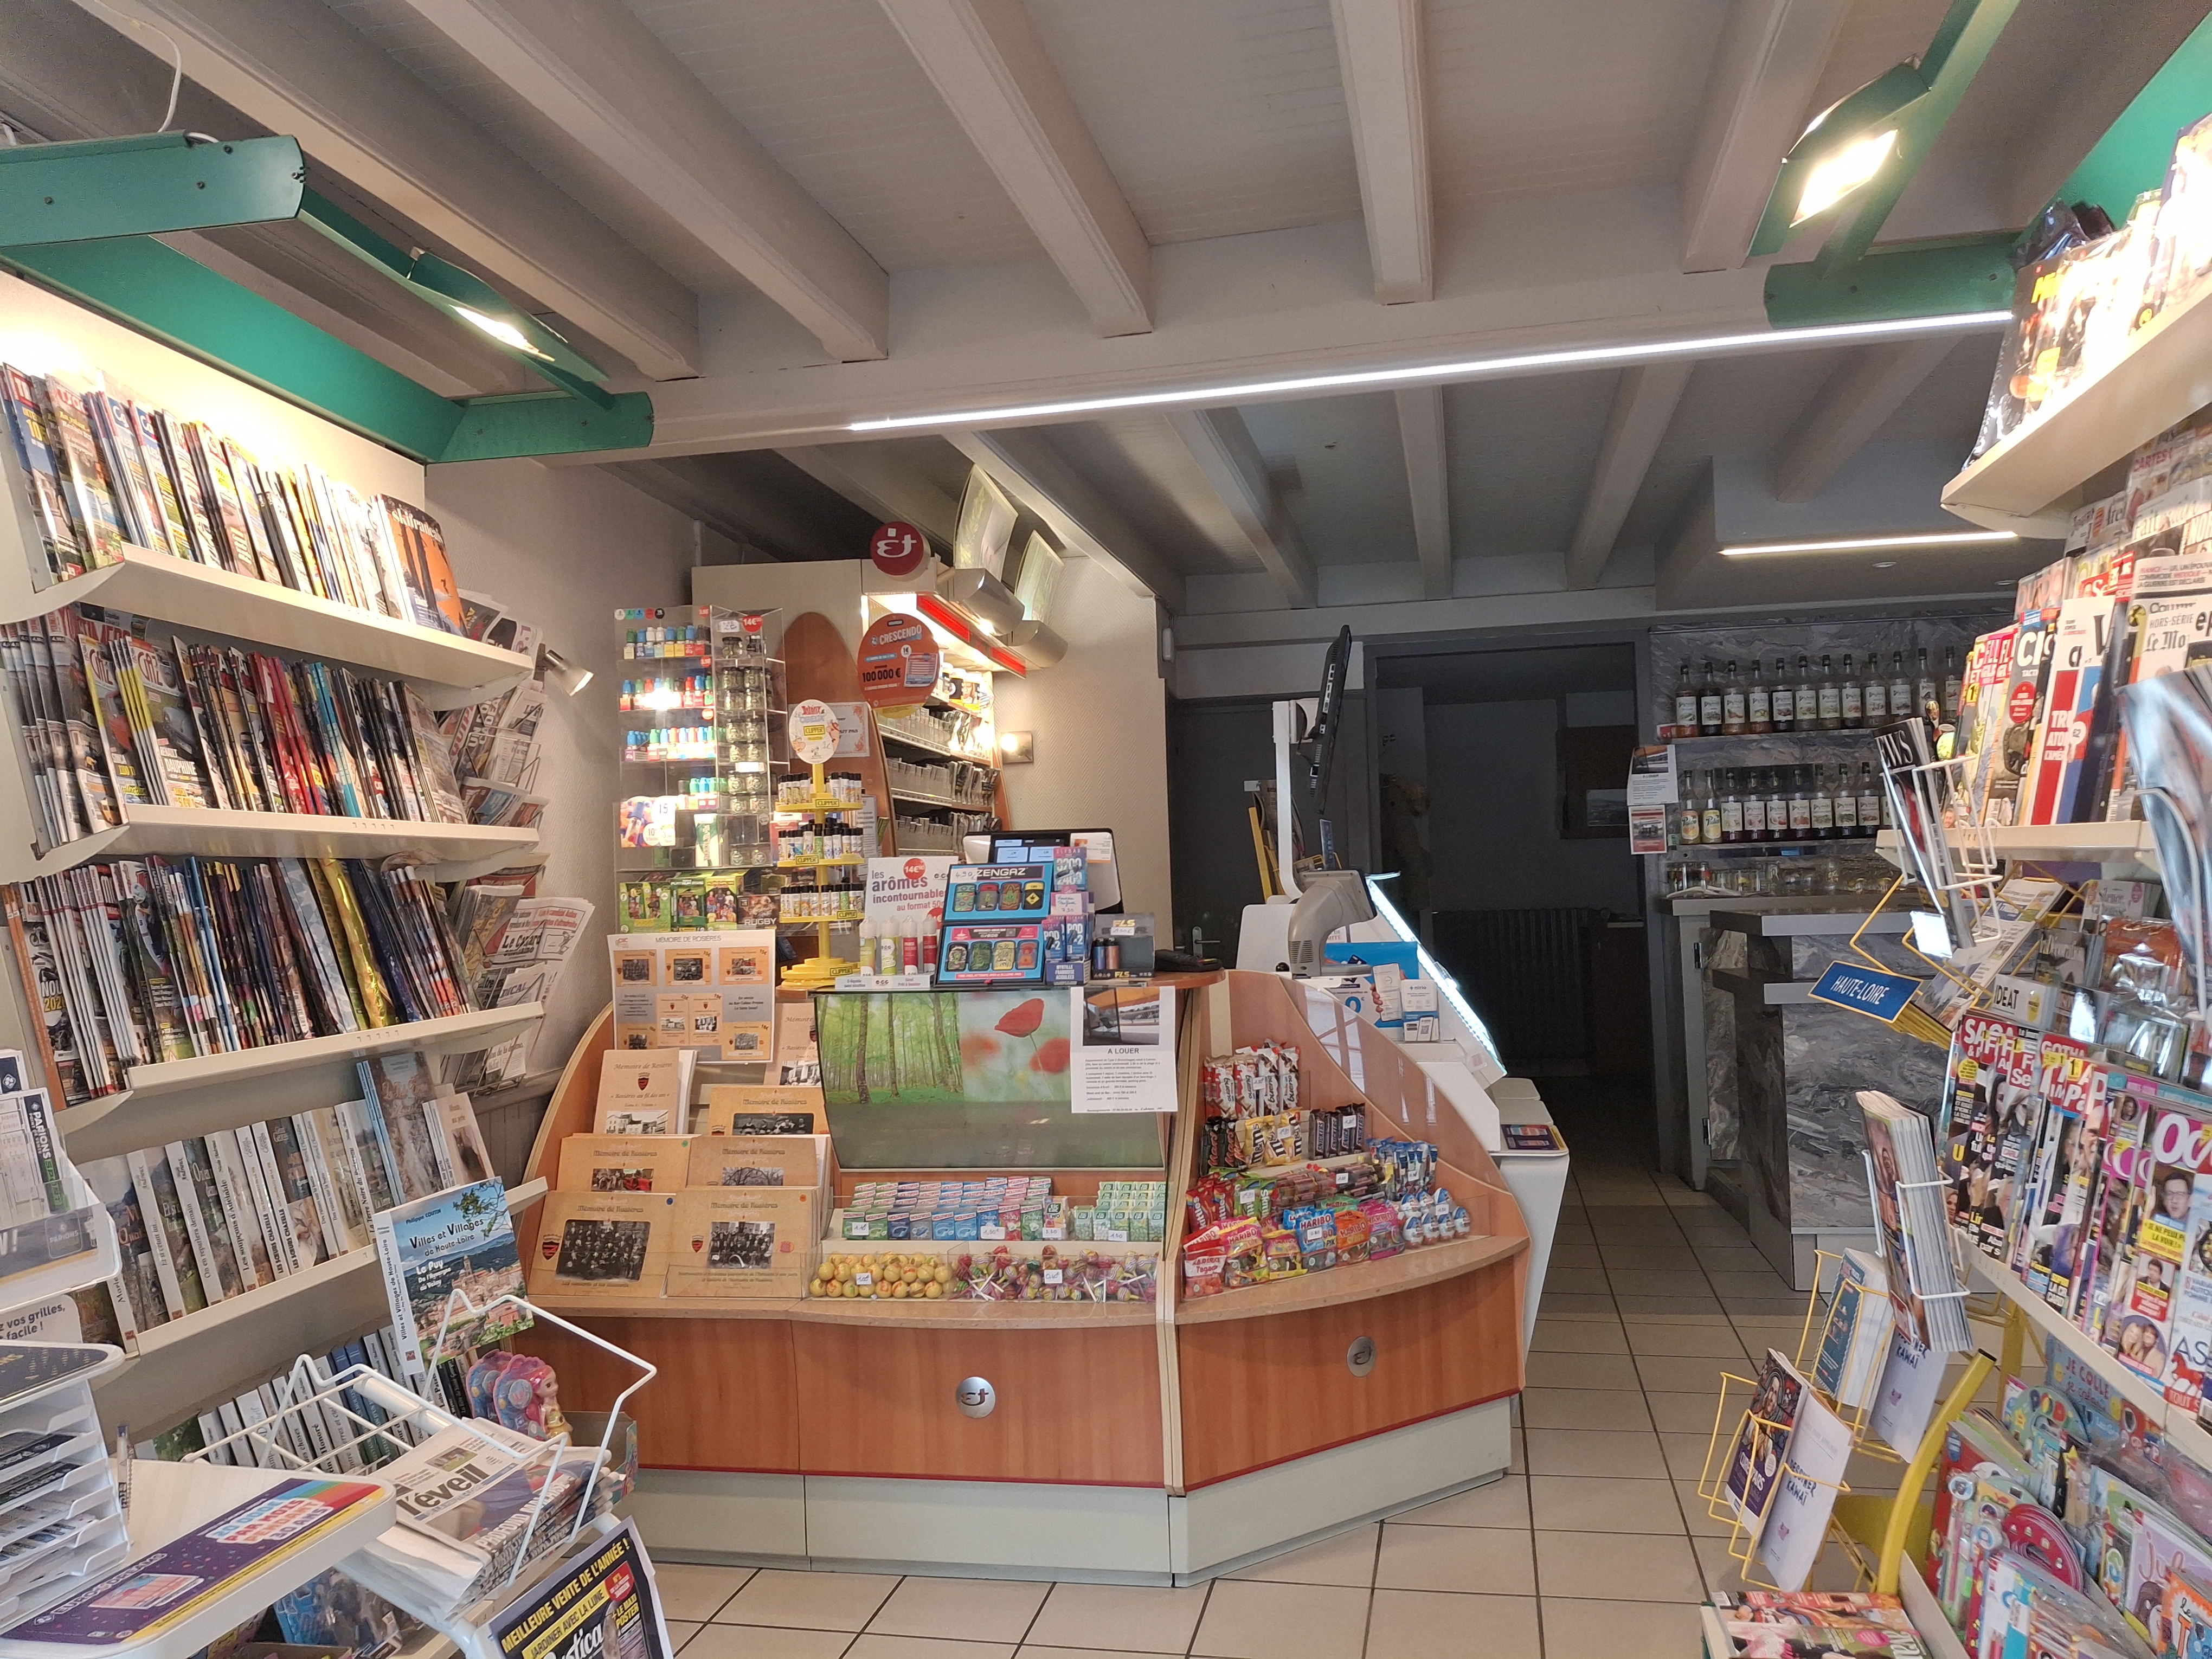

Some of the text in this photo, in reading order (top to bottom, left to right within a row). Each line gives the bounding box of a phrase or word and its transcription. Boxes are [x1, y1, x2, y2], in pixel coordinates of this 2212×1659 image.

[879, 625, 922, 645] CRESCENDO
[166, 757, 196, 775] DAUPHINE
[872, 870, 884, 879] les
[976, 867, 1026, 877] ZENGAZ
[872, 876, 928, 892] arômes
[907, 901, 930, 910] format
[744, 917, 777, 926] RUGBY
[502, 935, 513, 948] Le
[655, 935, 681, 943] MÉMOIRE
[1830, 975, 1890, 1005] HAUTE-LOIRE
[1223, 1077, 1231, 1102] bueno
[33, 1111, 52, 1159] PARIONS
[356, 1178, 363, 1187] du
[359, 1188, 369, 1205] Noire
[187, 1203, 197, 1227] demain
[364, 1206, 373, 1224] Terre
[425, 1208, 441, 1218] COUTIN
[1301, 1215, 1332, 1230] HARIBO
[1339, 1222, 1367, 1238] HARIBO
[233, 1221, 246, 1257] soupçons
[409, 1218, 485, 1249] Villes et Villages
[1227, 1227, 1257, 1244] HARIBO
[1326, 1237, 1335, 1246] PIK
[194, 1228, 207, 1258] reparlera
[425, 1233, 475, 1257] de Haute-Loire
[241, 1257, 249, 1271] Les
[290, 1255, 299, 1270] LES
[382, 1239, 394, 1276] Haute-Loire
[204, 1266, 211, 1278] On
[273, 1260, 284, 1274] LES
[416, 1259, 444, 1275] Le Puy
[390, 1278, 396, 1287] de
[428, 1279, 442, 1289] Velay
[393, 1287, 402, 1314] Villages
[7, 1303, 66, 1329] vos grilles,
[6, 1324, 38, 1340] facile
[398, 1322, 408, 1340] Villes
[2080, 1365, 2110, 1398] COLLE
[311, 1423, 327, 1457] Honoré
[396, 1463, 491, 1516] l'éveil
[1786, 1479, 1808, 1506] KAWAÏ
[224, 1500, 305, 1541] PAR MOIS
[474, 1512, 531, 1548] PROFOND
[501, 1601, 555, 1653] MEILLEURE
[551, 1578, 582, 1610] VENTE
[578, 1568, 594, 1588] DE
[590, 1542, 625, 1577] L'ANNÉE
[623, 1537, 630, 1550] !
[530, 1589, 605, 1657] JARDINER AVEC LA LUNE
[615, 1602, 640, 1629] POSTER
